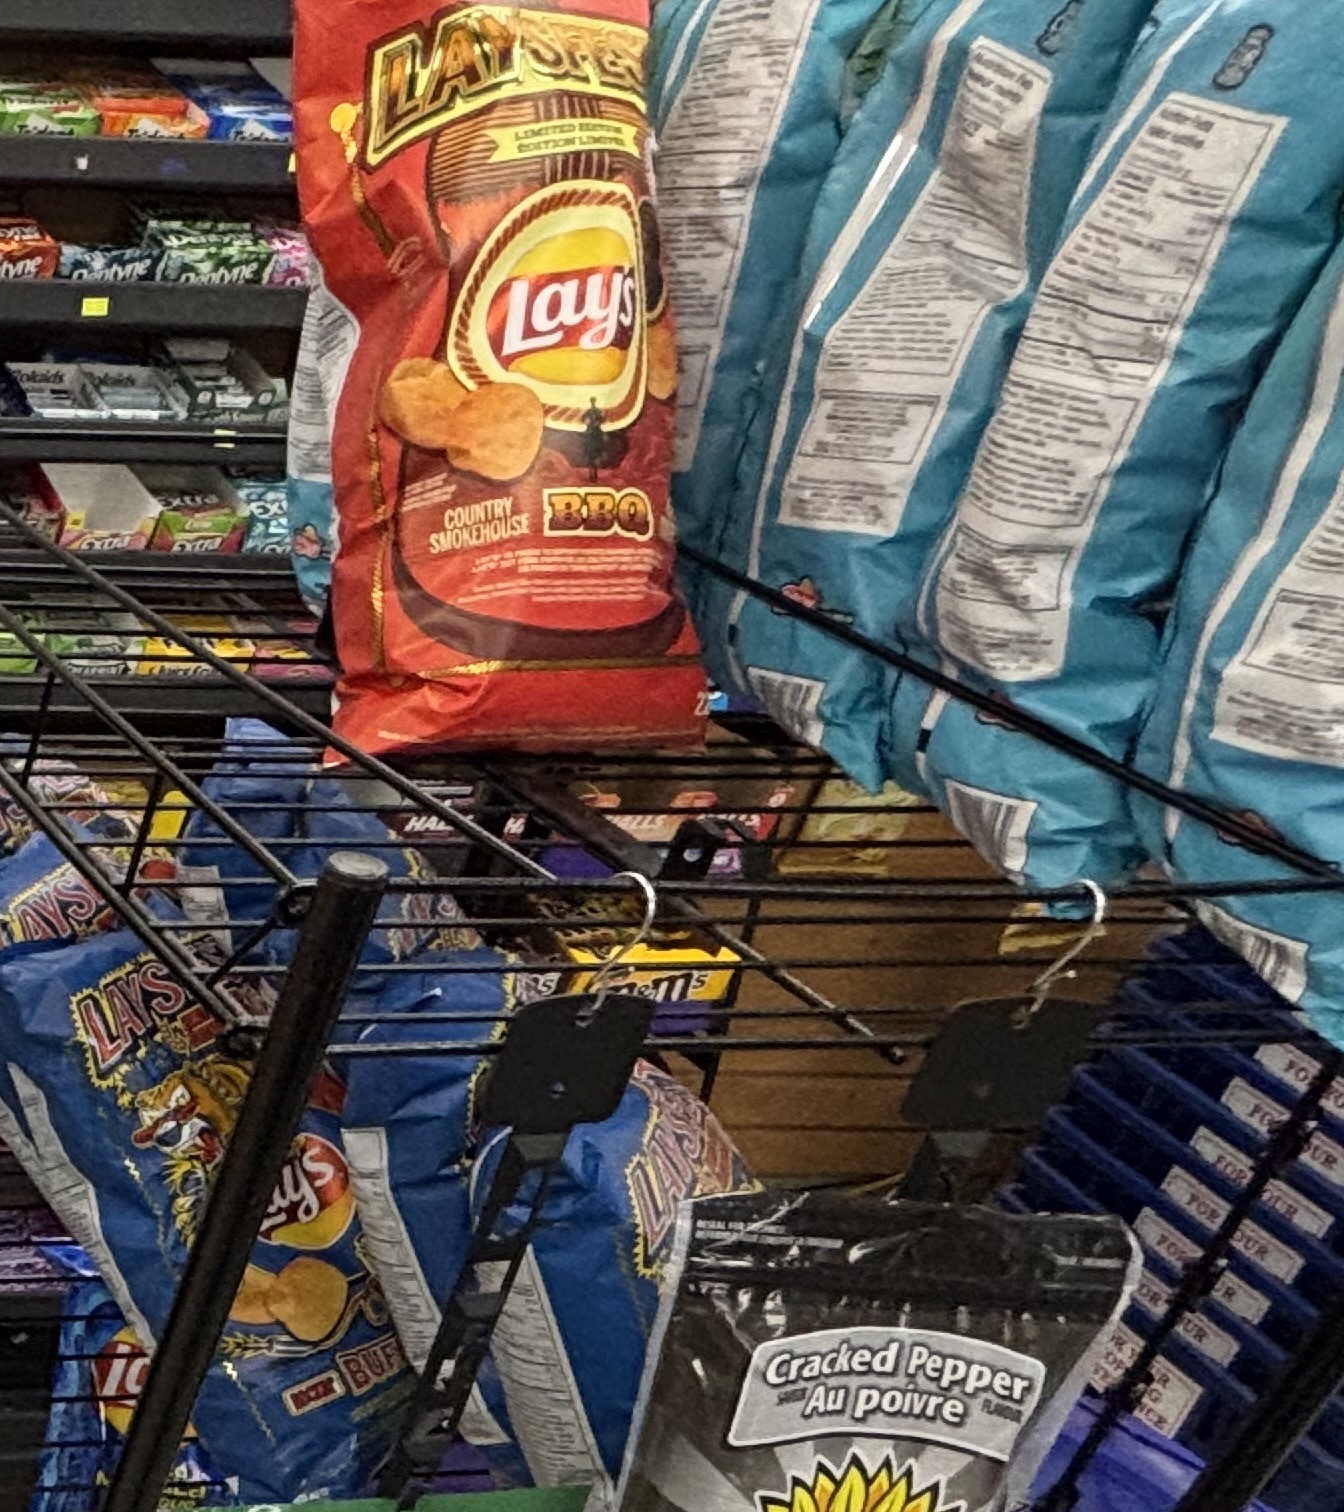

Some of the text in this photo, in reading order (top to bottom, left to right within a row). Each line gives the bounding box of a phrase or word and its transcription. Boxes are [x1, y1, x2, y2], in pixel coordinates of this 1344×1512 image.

[502, 266, 636, 355] Lay's
[429, 513, 529, 554] SMOKEHOUSE
[445, 497, 513, 528] COUNTRY
[543, 487, 653, 541] BBQ
[765, 1342, 900, 1384] Cracked
[907, 1343, 1029, 1400] Pepper
[803, 1385, 846, 1417] Au
[853, 1383, 963, 1423] poivre
